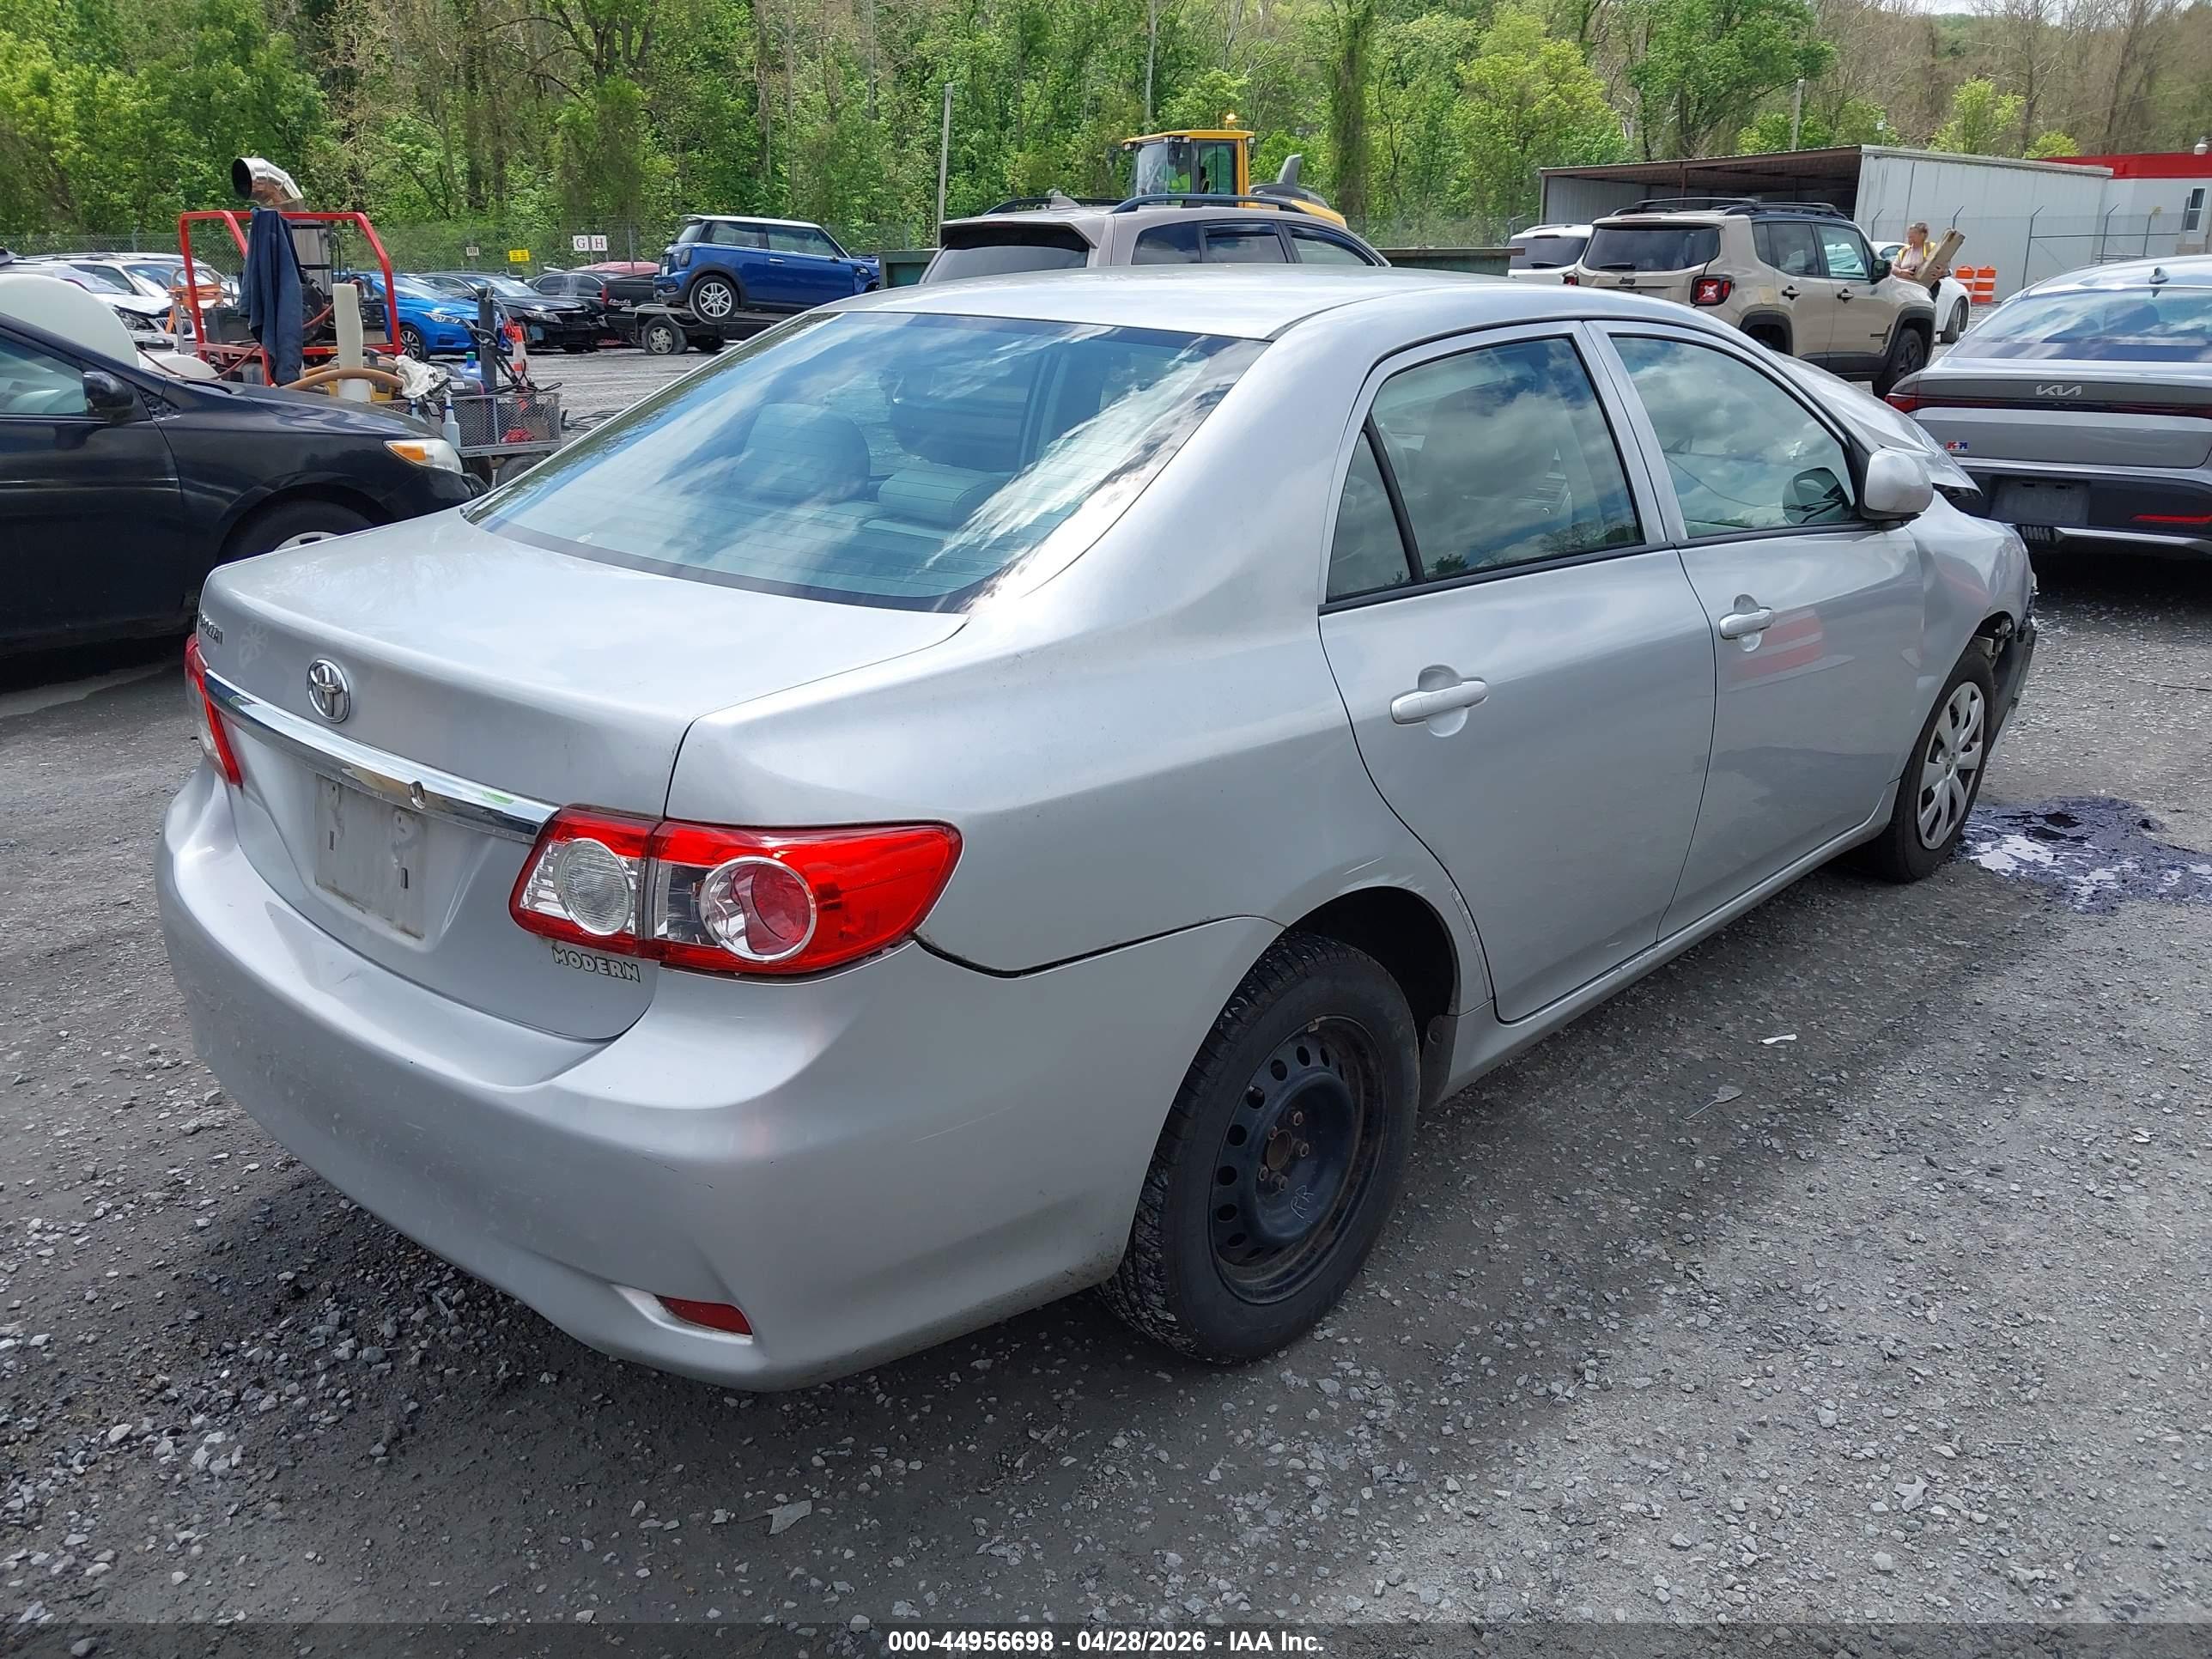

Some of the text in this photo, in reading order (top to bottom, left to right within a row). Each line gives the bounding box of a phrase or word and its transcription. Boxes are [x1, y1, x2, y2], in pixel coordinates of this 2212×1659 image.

[576, 238, 586, 249] G
[594, 238, 604, 248] H
[551, 945, 641, 983] MODERN
